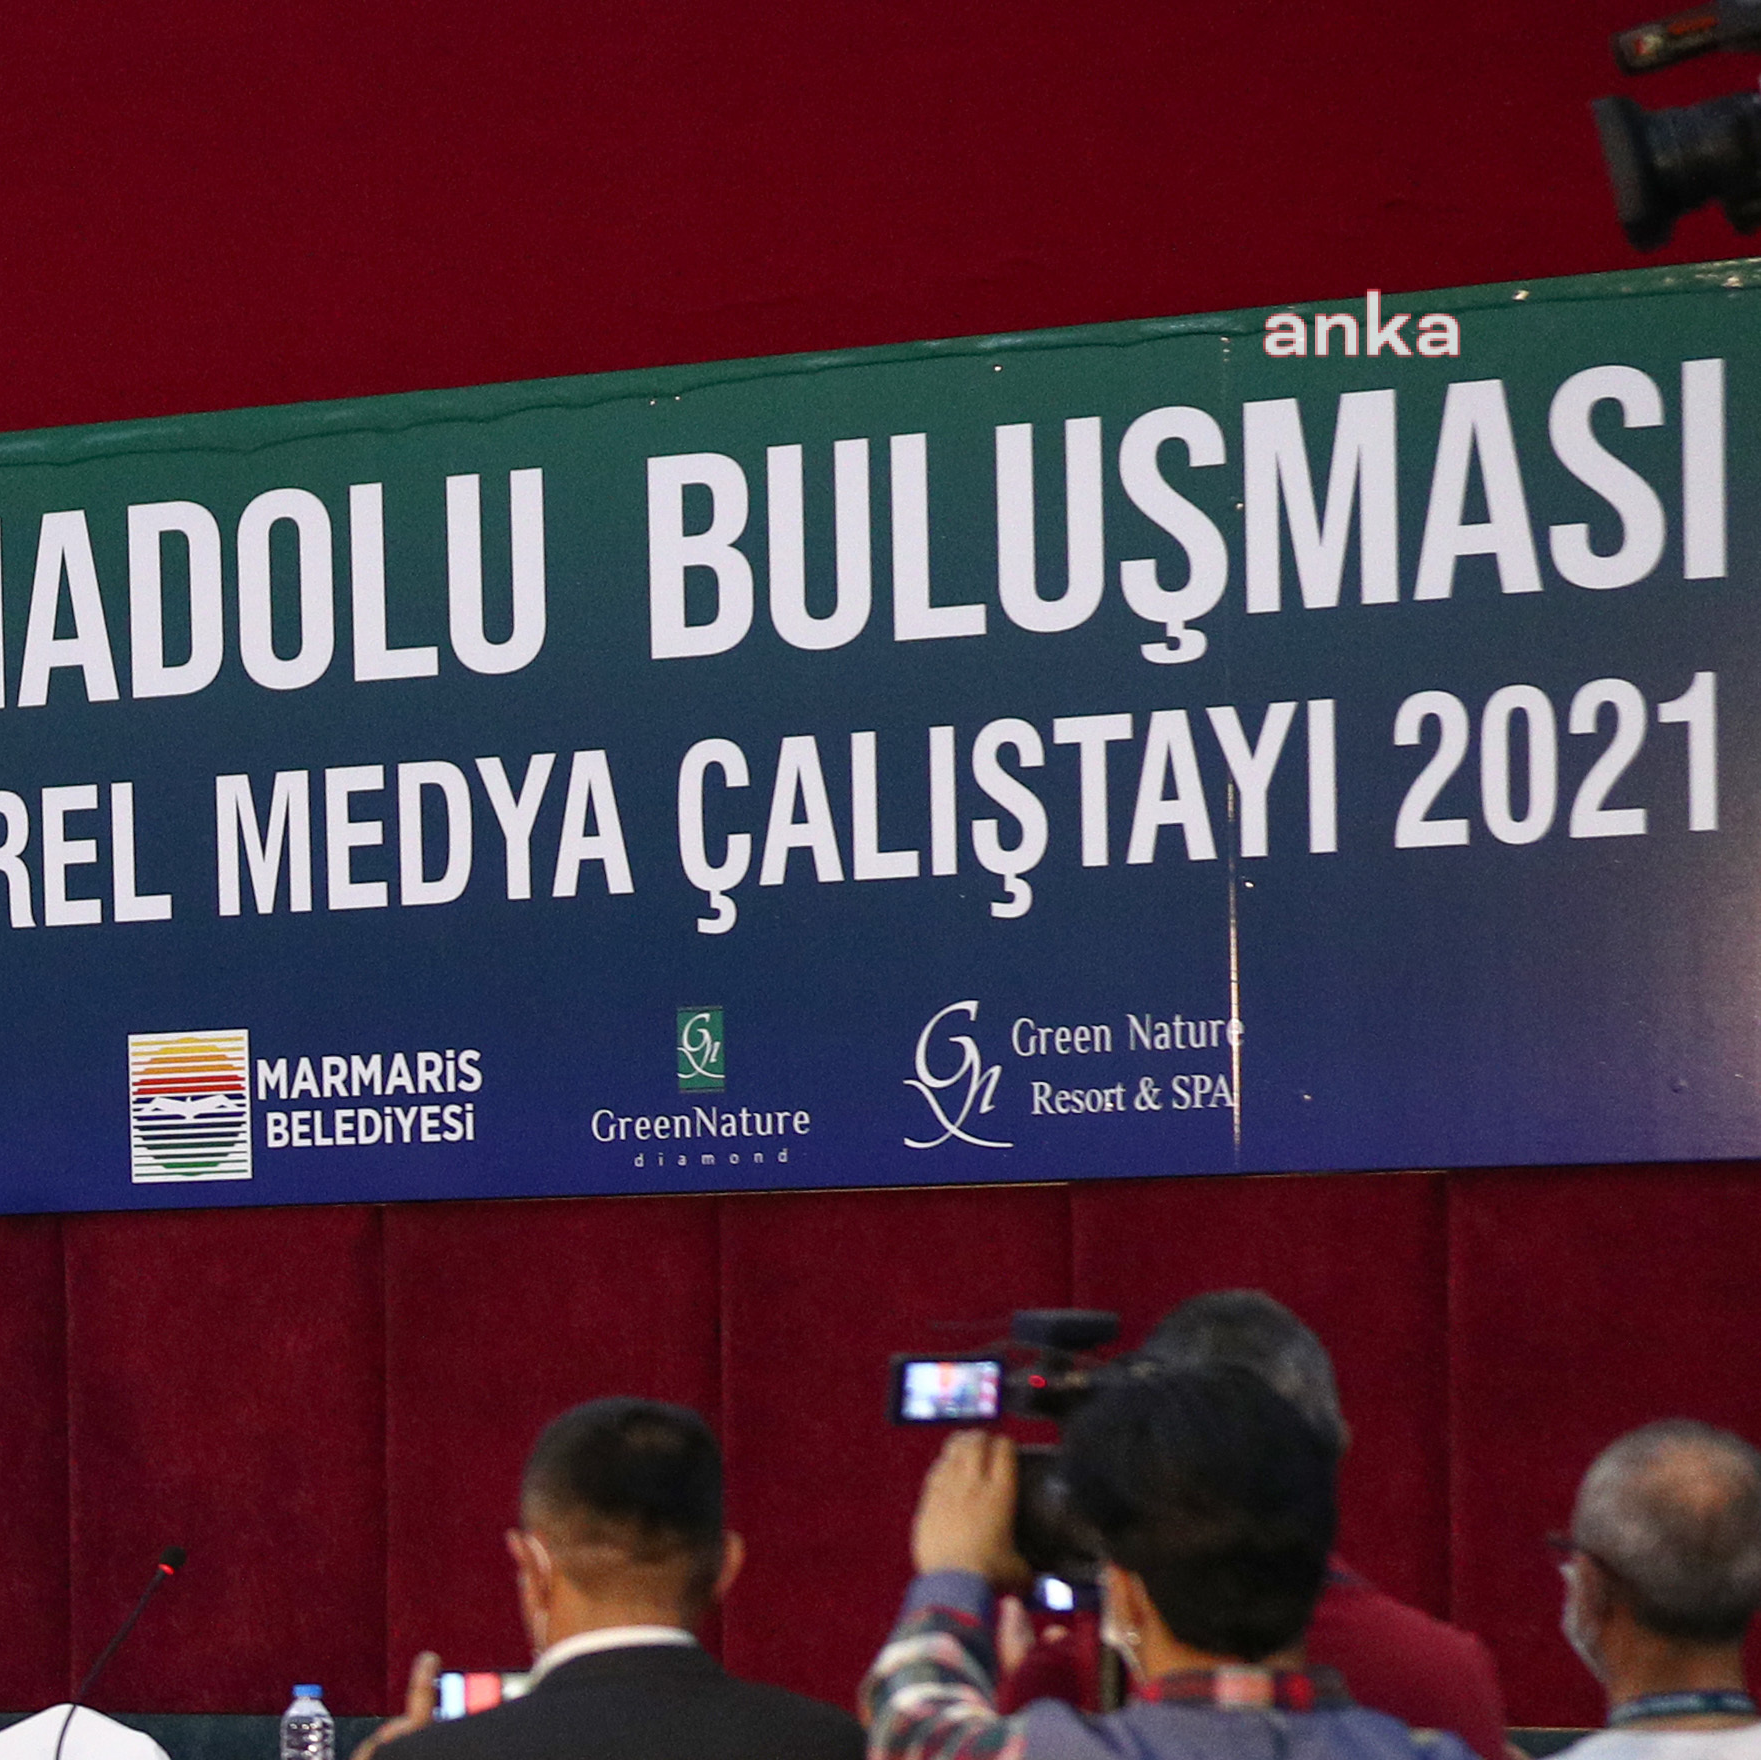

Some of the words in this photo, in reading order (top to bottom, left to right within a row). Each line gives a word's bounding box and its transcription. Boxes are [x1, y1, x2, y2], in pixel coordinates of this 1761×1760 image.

[647, 358, 1728, 664] BULUŞMASI
[216, 749, 635, 917] MEDYA
[678, 698, 1338, 935] ÇALIŞTAYI
[1394, 671, 1718, 849] 2021
[1012, 1017, 1112, 1057] Green
[1126, 1013, 1245, 1052] Nature
[1031, 1081, 1127, 1115] Resort
[1134, 1076, 1163, 1111] &
[1171, 1074, 1237, 1110] SPA
[591, 1106, 811, 1142] GreenNature
[634, 1148, 789, 1168] diamond
